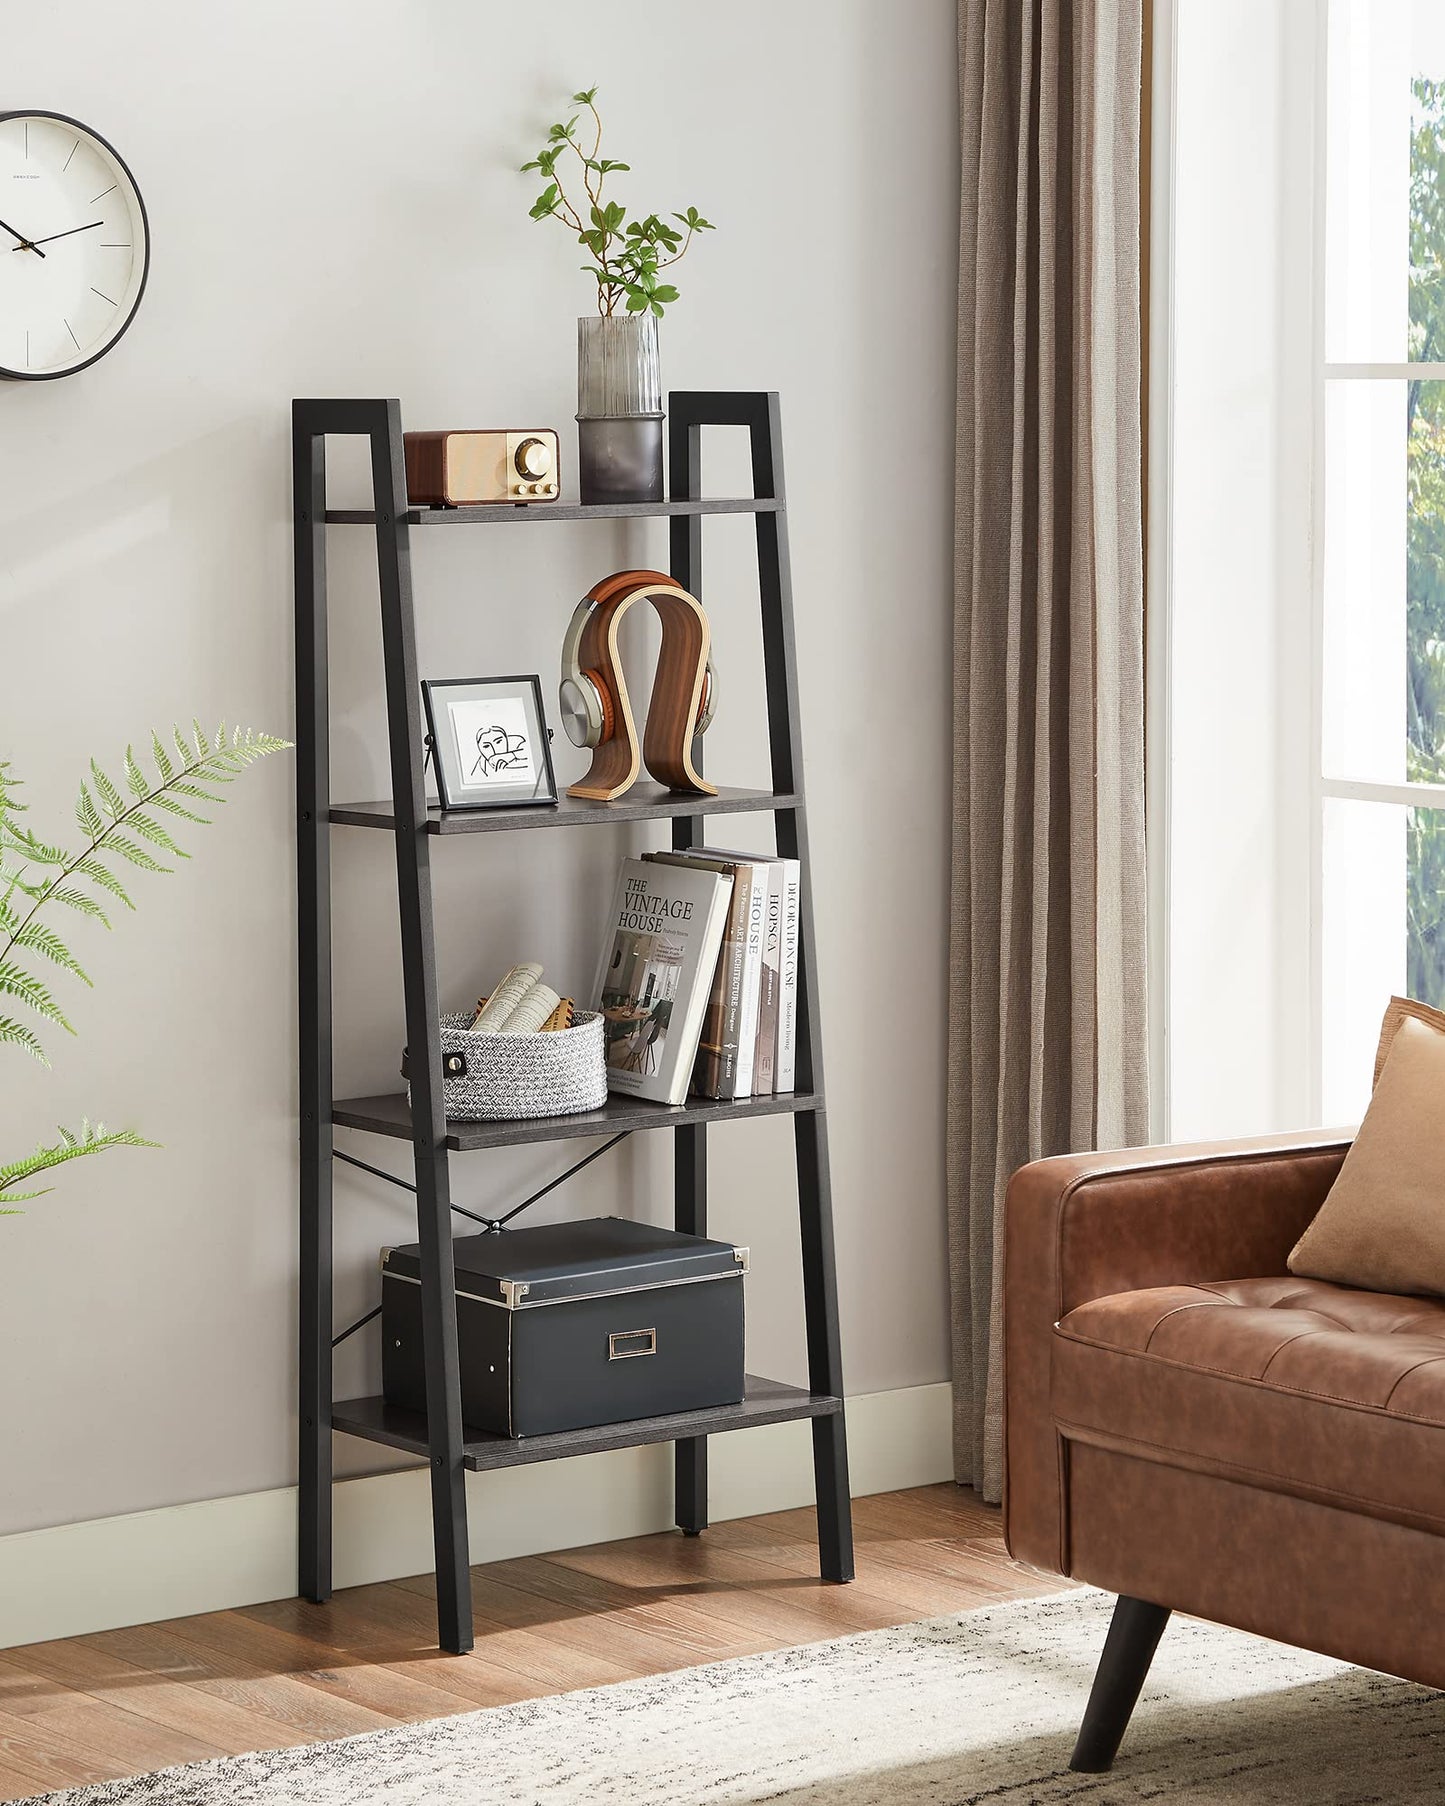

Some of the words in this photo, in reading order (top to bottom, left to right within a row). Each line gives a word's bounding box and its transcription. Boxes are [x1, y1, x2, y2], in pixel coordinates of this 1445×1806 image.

[627, 878, 648, 893] THE
[624, 892, 694, 920] VINTAGE
[786, 882, 797, 958] DECORATION
[618, 911, 664, 933] HOUSE
[736, 925, 745, 941] ART
[748, 896, 762, 954] HOUSE
[767, 894, 779, 952] HOPSCA
[731, 947, 742, 1007] ARCHITECTURE
[785, 960, 795, 990] CASE
